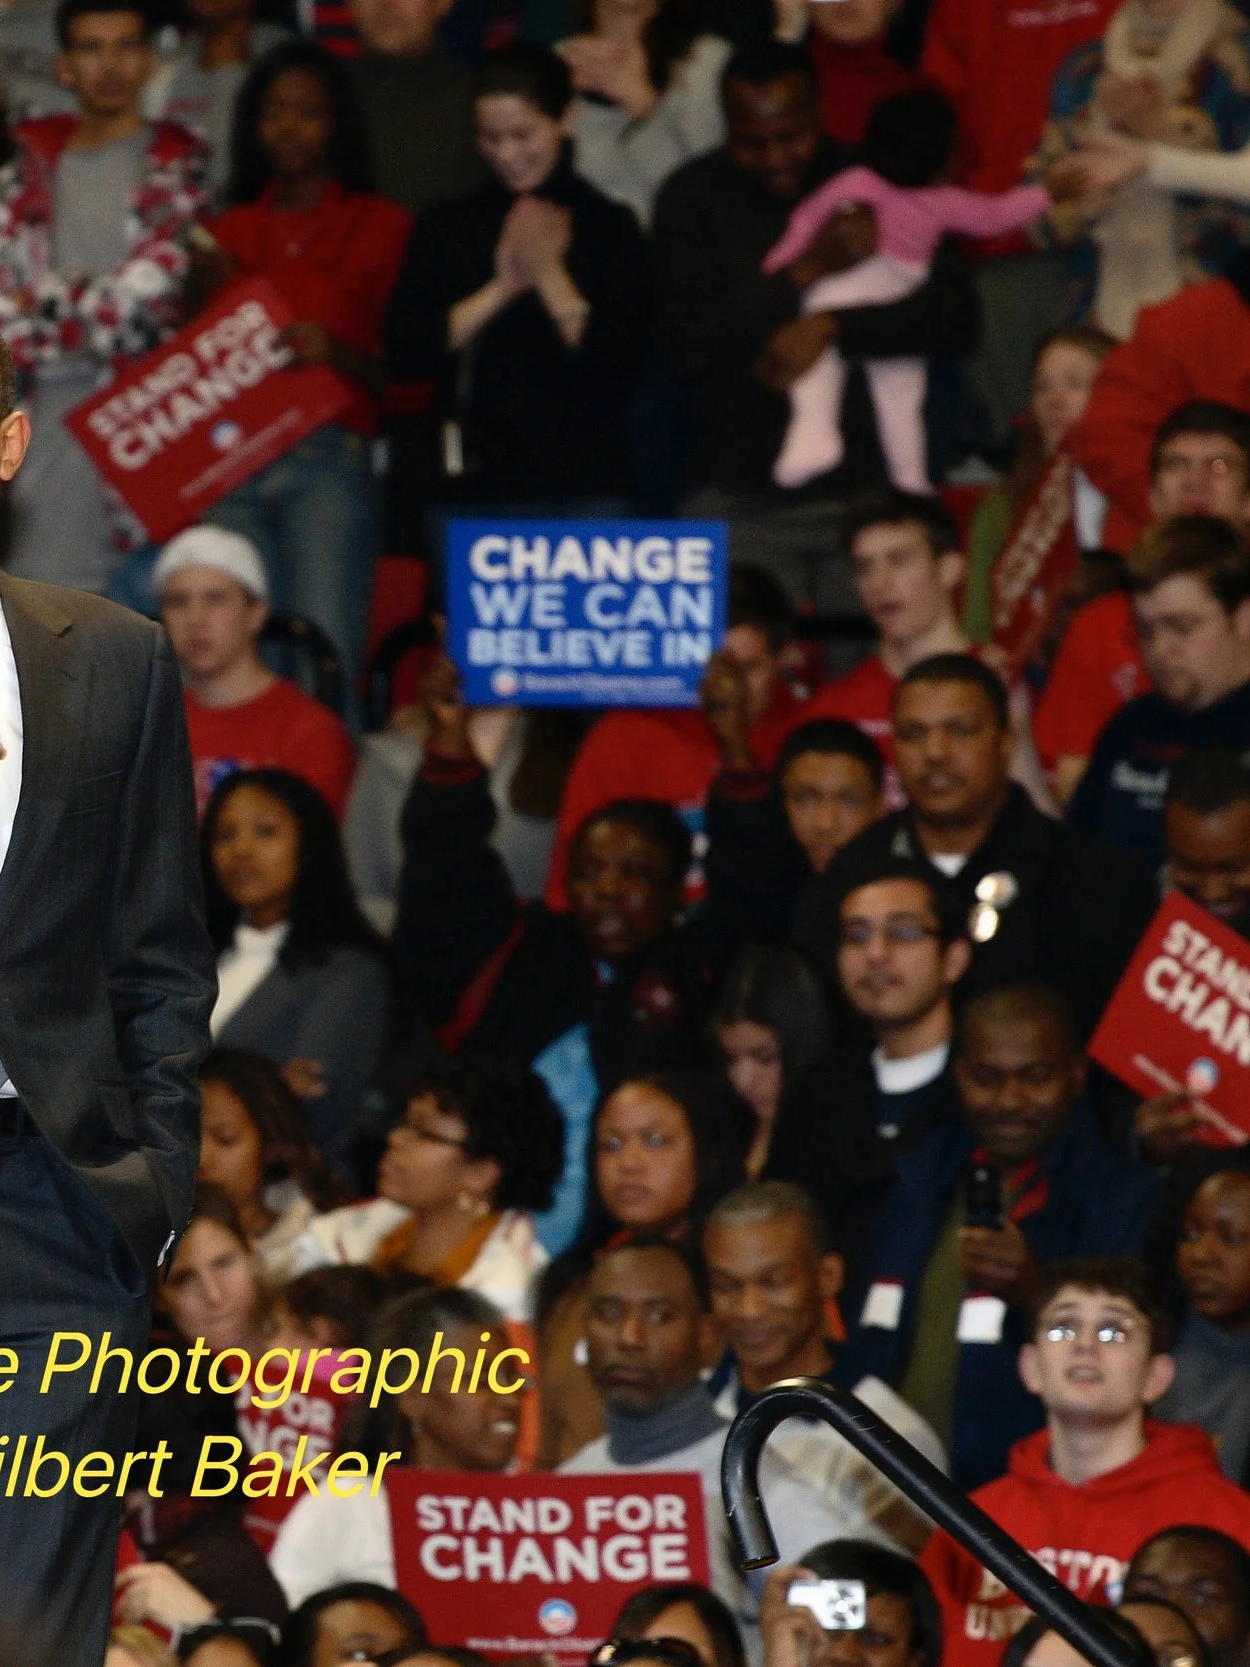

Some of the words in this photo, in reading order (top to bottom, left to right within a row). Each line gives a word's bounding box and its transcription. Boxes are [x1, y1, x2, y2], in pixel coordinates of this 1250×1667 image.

[87, 353, 198, 442] STAND
[194, 299, 268, 374] FOR
[109, 325, 295, 471] CHANGE
[469, 534, 714, 584] CHANGE
[469, 581, 568, 628] WE
[583, 582, 714, 630] CAN
[467, 627, 652, 668] BELIEVE
[660, 630, 713, 668] IN
[415, 1493, 573, 1534] STAND
[585, 1494, 687, 1533] FOR
[419, 1533, 692, 1583] CHANGE
